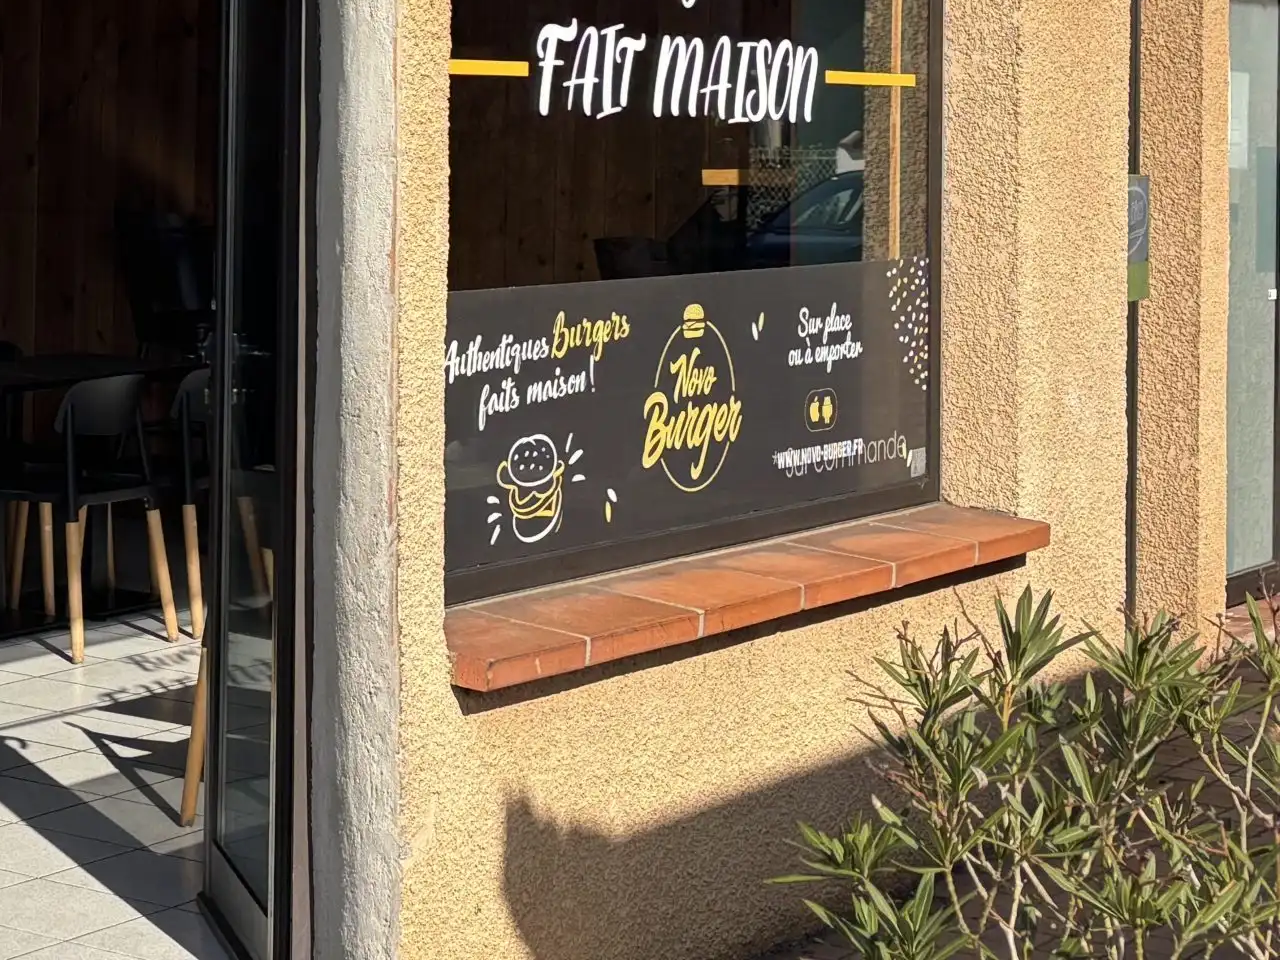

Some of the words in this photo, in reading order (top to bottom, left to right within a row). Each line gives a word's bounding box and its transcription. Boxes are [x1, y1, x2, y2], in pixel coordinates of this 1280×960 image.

[536, 17, 647, 121] FAIT
[652, 33, 820, 125] MAISON
[444, 333, 550, 385] Authentiques
[550, 310, 631, 362] Burgers
[798, 307, 823, 338] Sur
[822, 302, 853, 345] place
[669, 347, 718, 403] Novo
[787, 348, 803, 367] ou
[804, 337, 814, 365] à
[814, 331, 864, 374] emporter
[478, 376, 521, 431] faits
[641, 391, 743, 481] Burger
